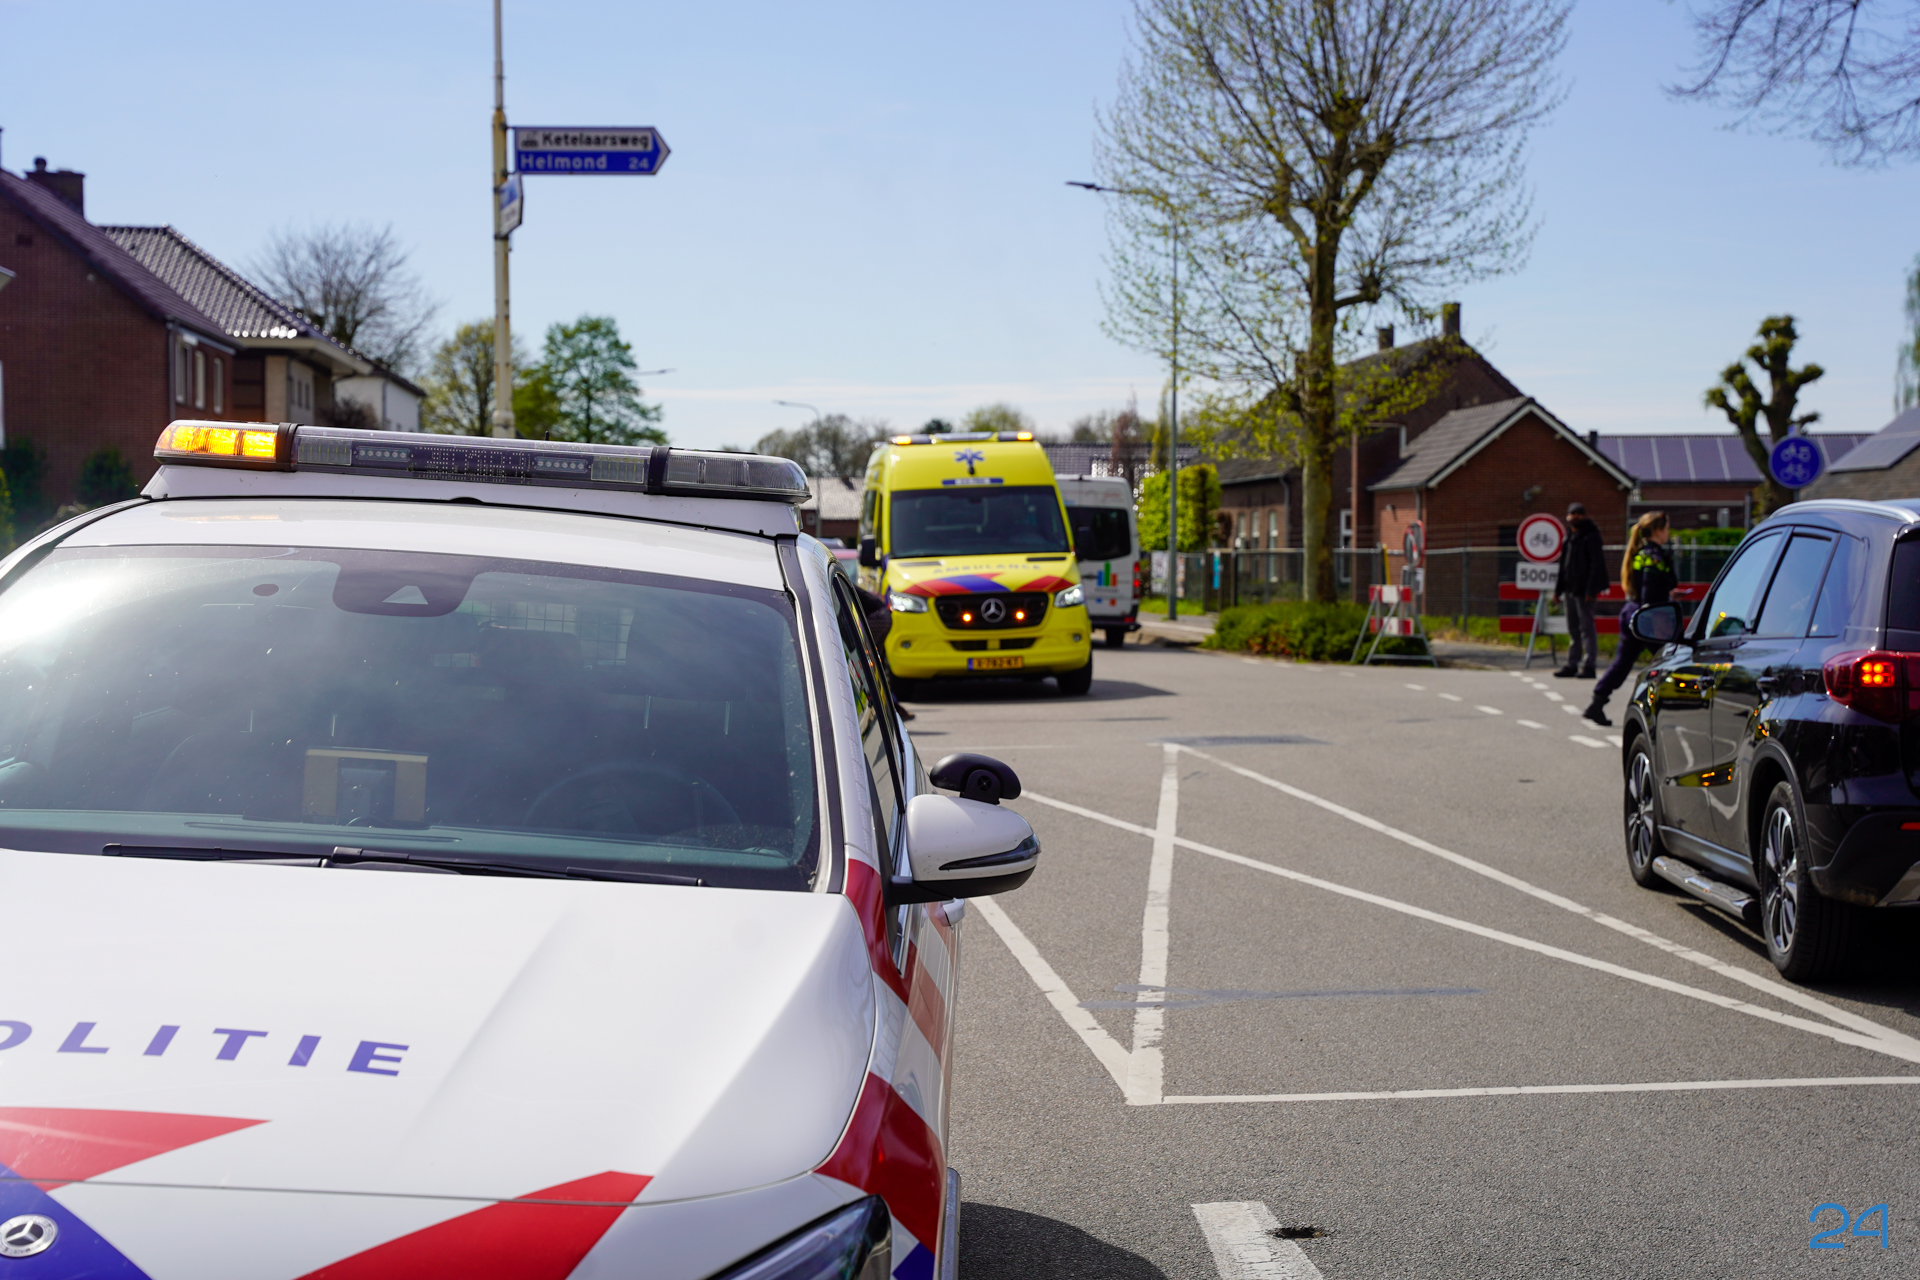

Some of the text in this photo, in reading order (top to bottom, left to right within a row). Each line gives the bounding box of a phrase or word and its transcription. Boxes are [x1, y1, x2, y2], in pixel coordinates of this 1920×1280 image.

[542, 132, 649, 149] Ketelaarsweg
[520, 154, 649, 169] Helmond 24
